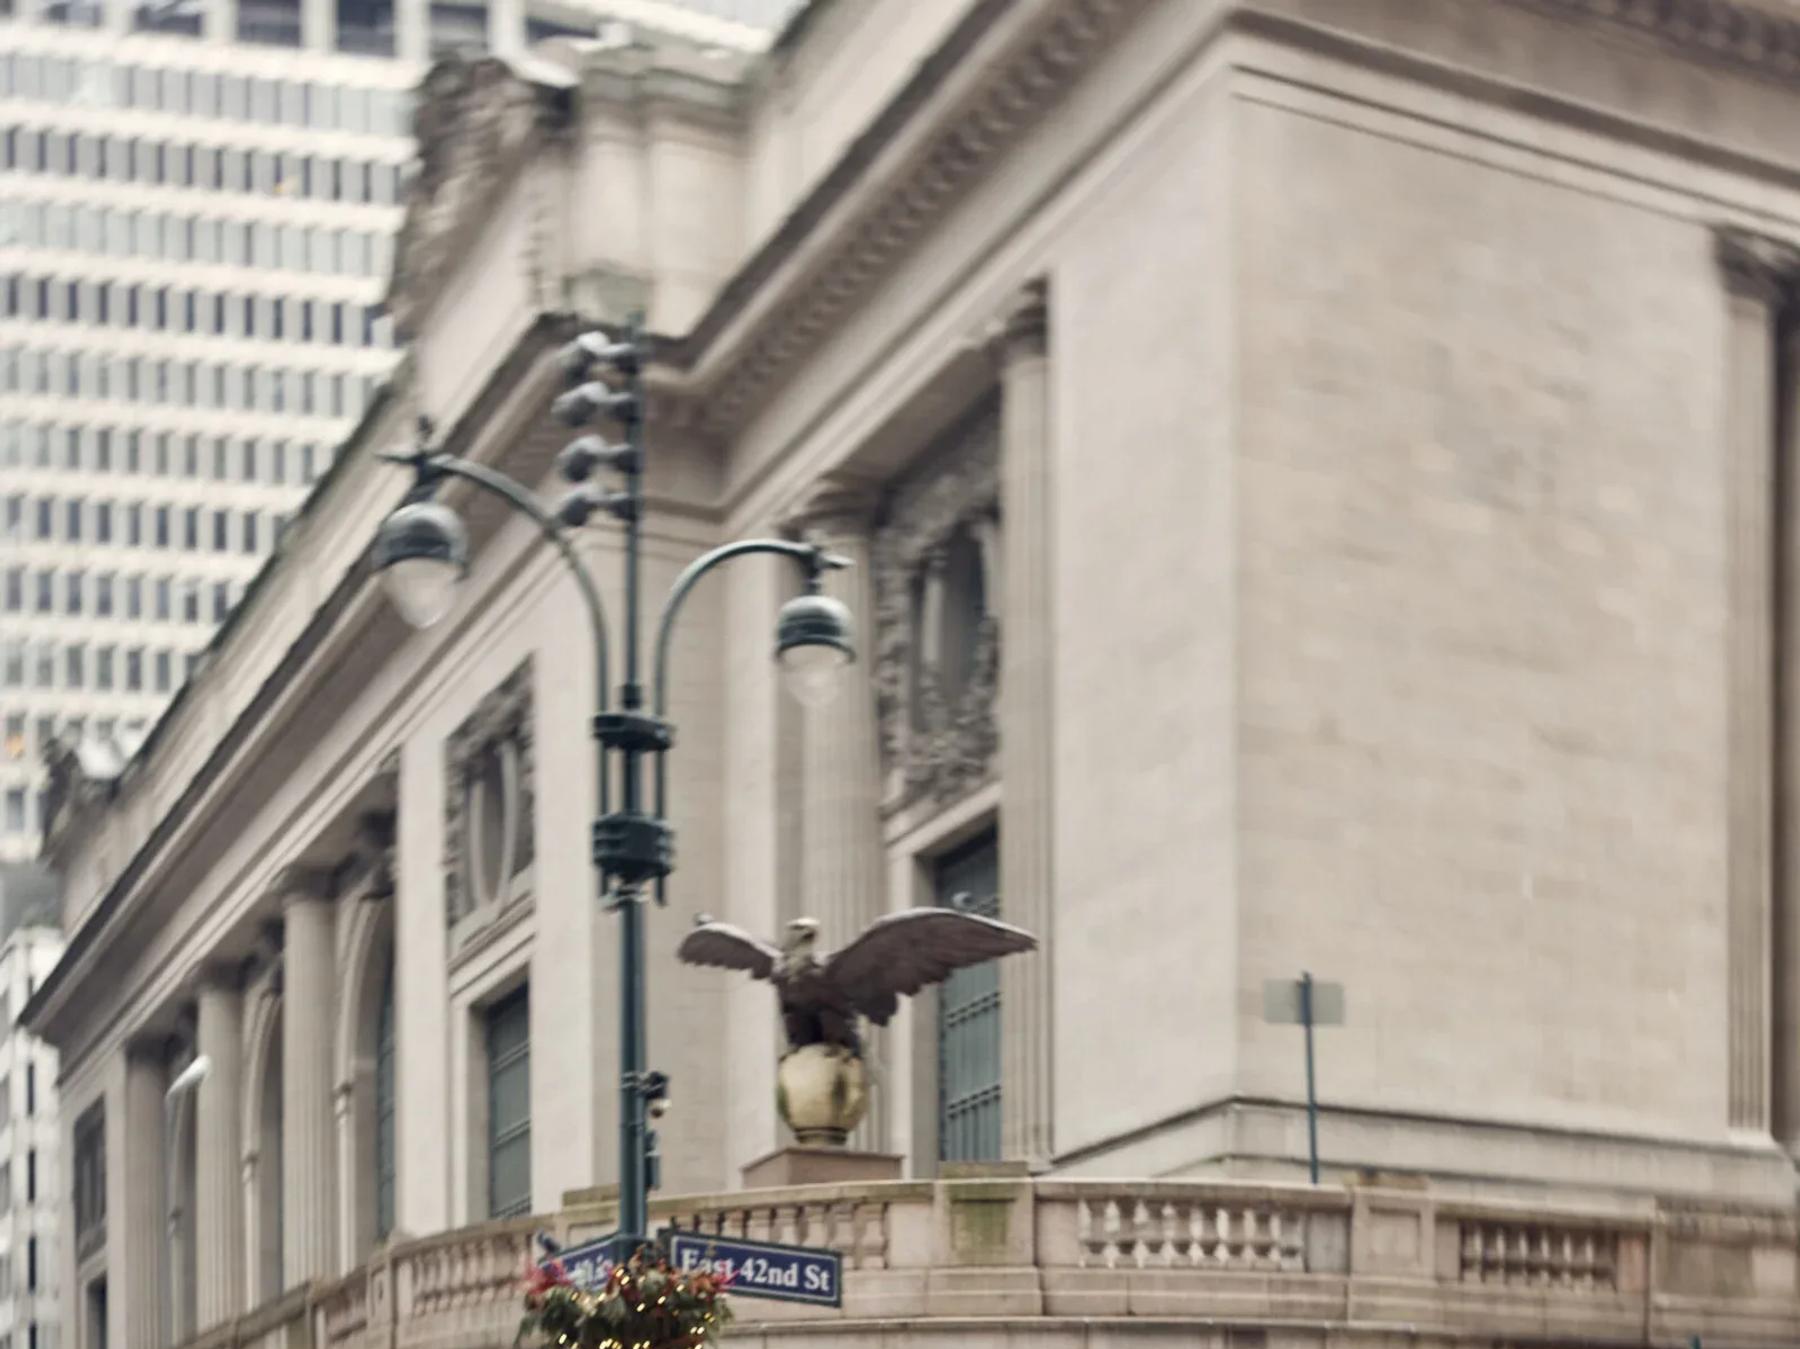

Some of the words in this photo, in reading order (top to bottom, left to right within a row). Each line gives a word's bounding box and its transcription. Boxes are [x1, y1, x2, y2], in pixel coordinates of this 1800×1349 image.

[681, 1248, 735, 1279] East
[740, 1257, 799, 1287] 42nd
[804, 1264, 831, 1292] St
